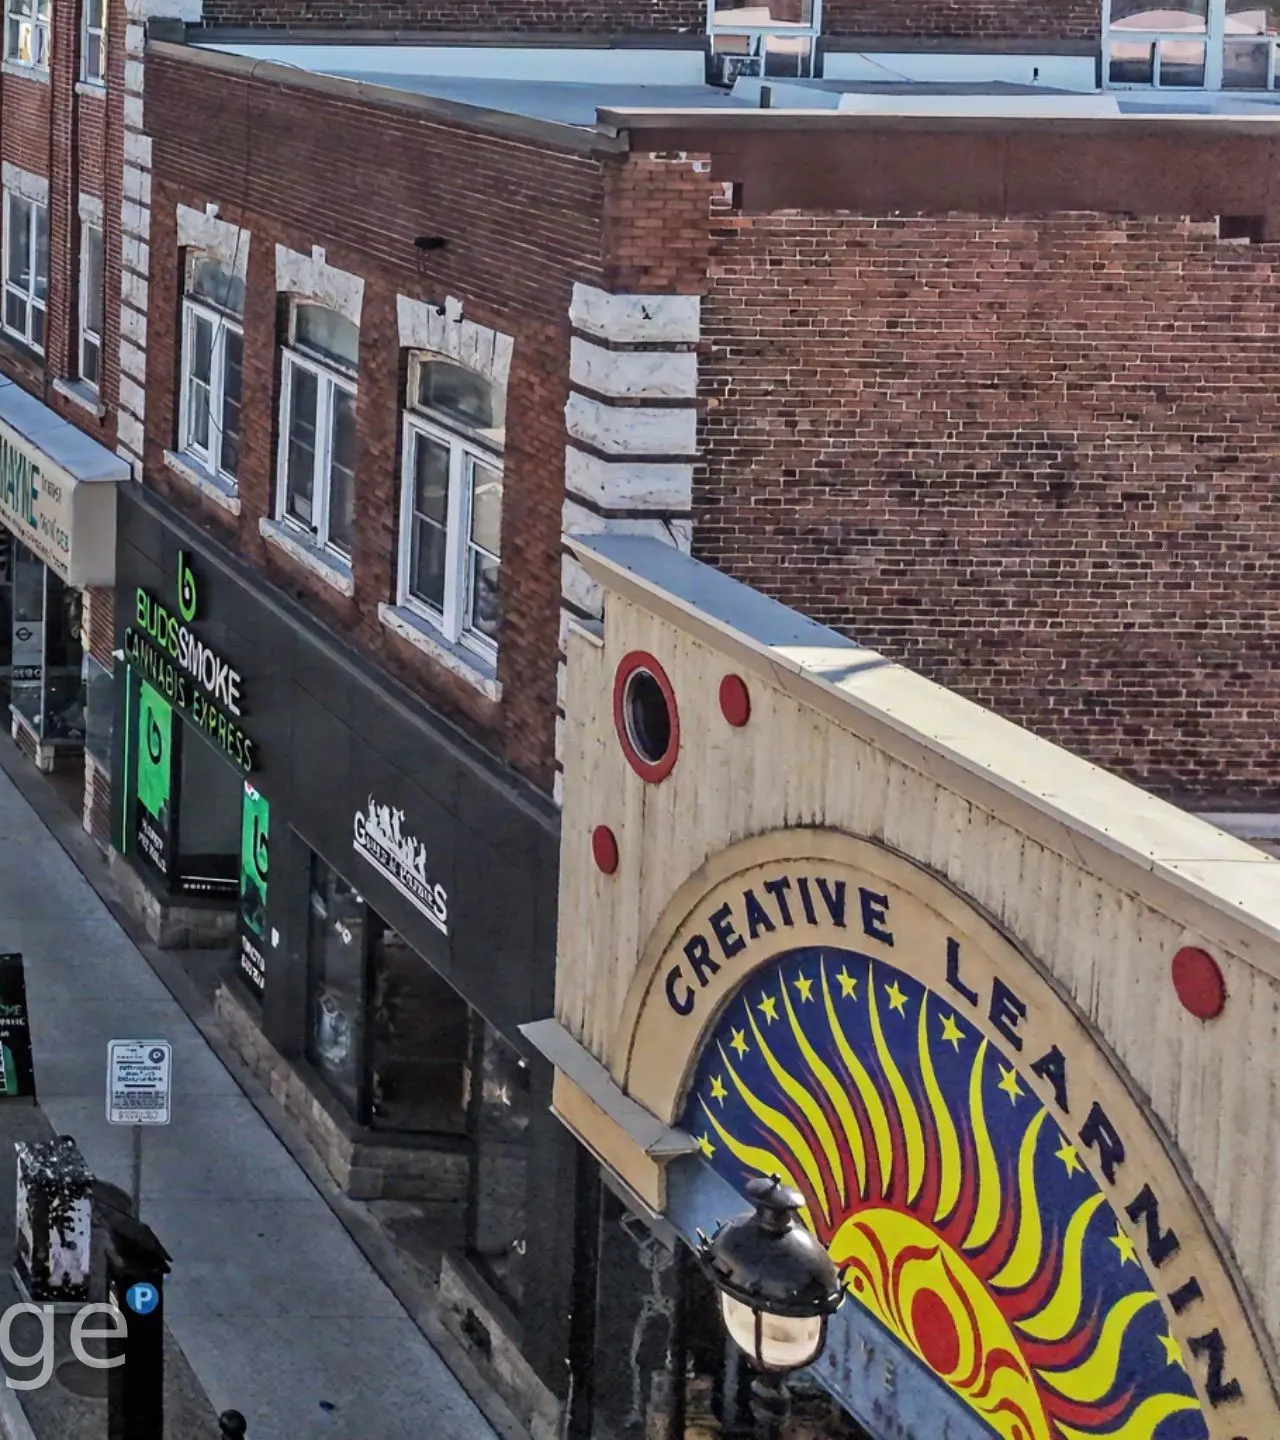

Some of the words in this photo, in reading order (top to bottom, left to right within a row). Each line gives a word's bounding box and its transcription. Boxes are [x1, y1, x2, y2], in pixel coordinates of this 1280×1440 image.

[124, 626, 186, 709] CANNABIS
[192, 690, 252, 772] EXPRESS
[664, 875, 895, 1017] CREATIVE
[945, 936, 1248, 1440] LEARNIN
